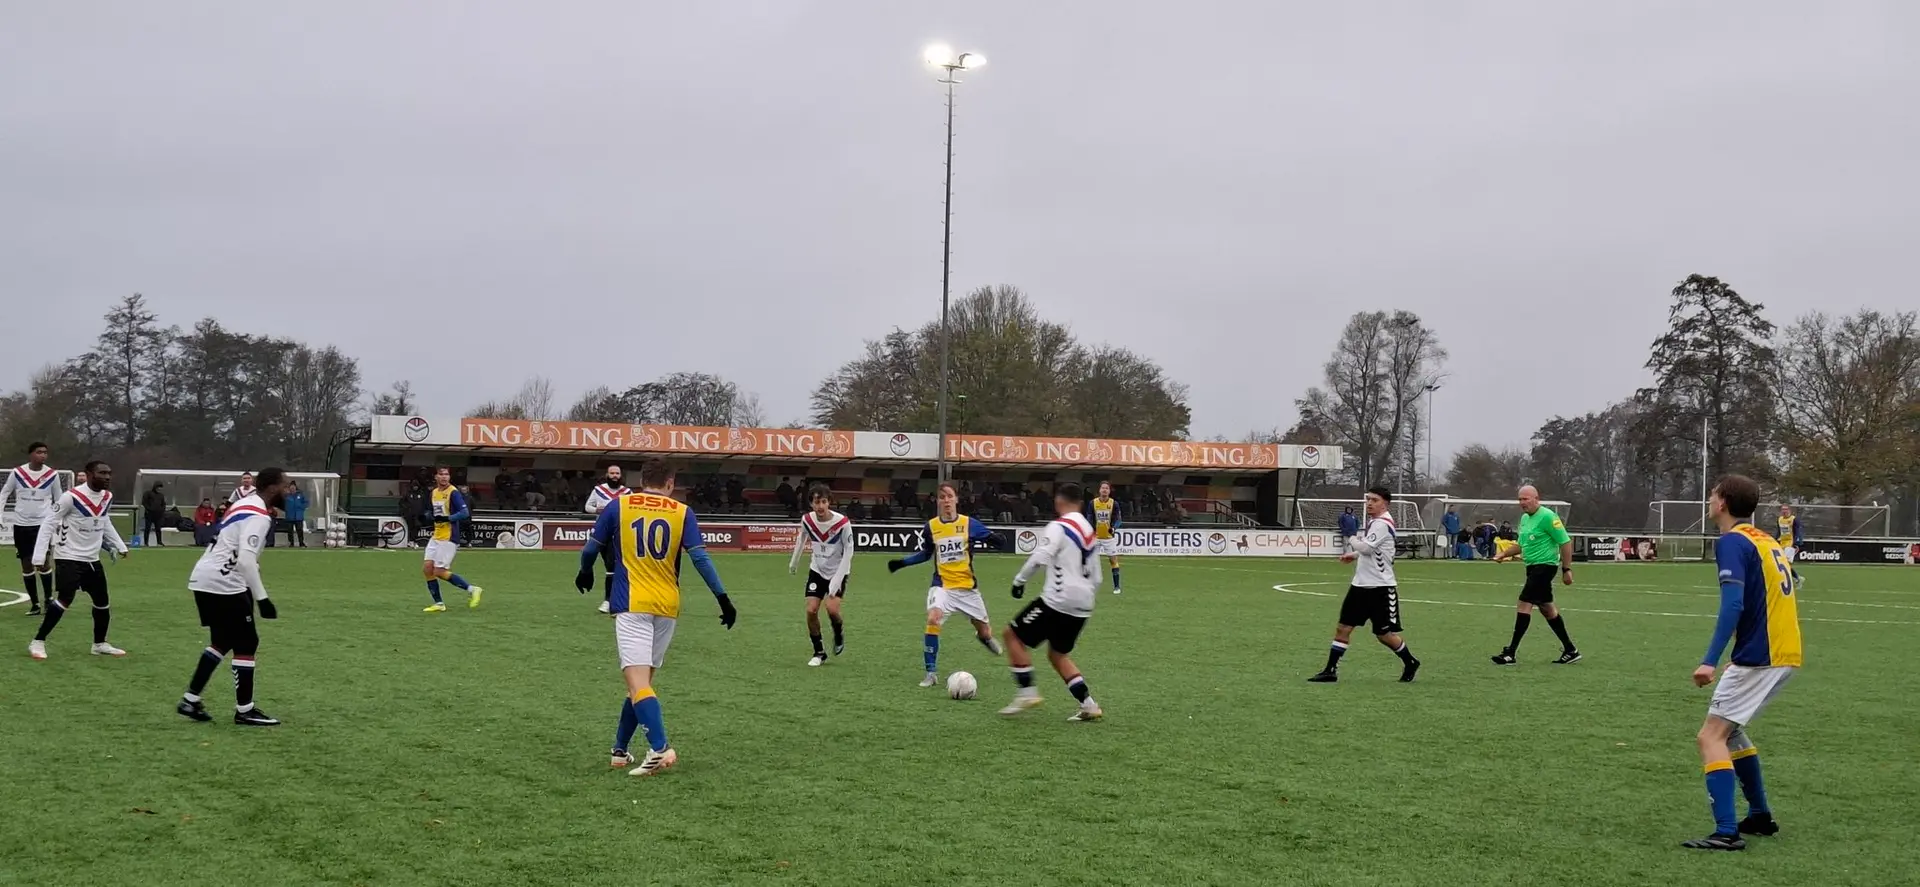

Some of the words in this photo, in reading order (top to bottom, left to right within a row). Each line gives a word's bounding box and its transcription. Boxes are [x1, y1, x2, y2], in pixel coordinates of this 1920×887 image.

[465, 424, 523, 445] ING
[569, 427, 623, 448] ING
[669, 431, 722, 451] ING
[764, 433, 815, 454] ING
[949, 439, 997, 459] ING
[1035, 442, 1081, 461] ING
[1120, 445, 1165, 464] ING
[1202, 447, 1246, 465] ING
[629, 495, 678, 510] BSN
[631, 516, 671, 561] 10
[857, 533, 911, 547] DAILY
[1255, 533, 1327, 548] CHAABI
[1800, 550, 1840, 561] Domino's
[1771, 549, 1793, 596] 5
